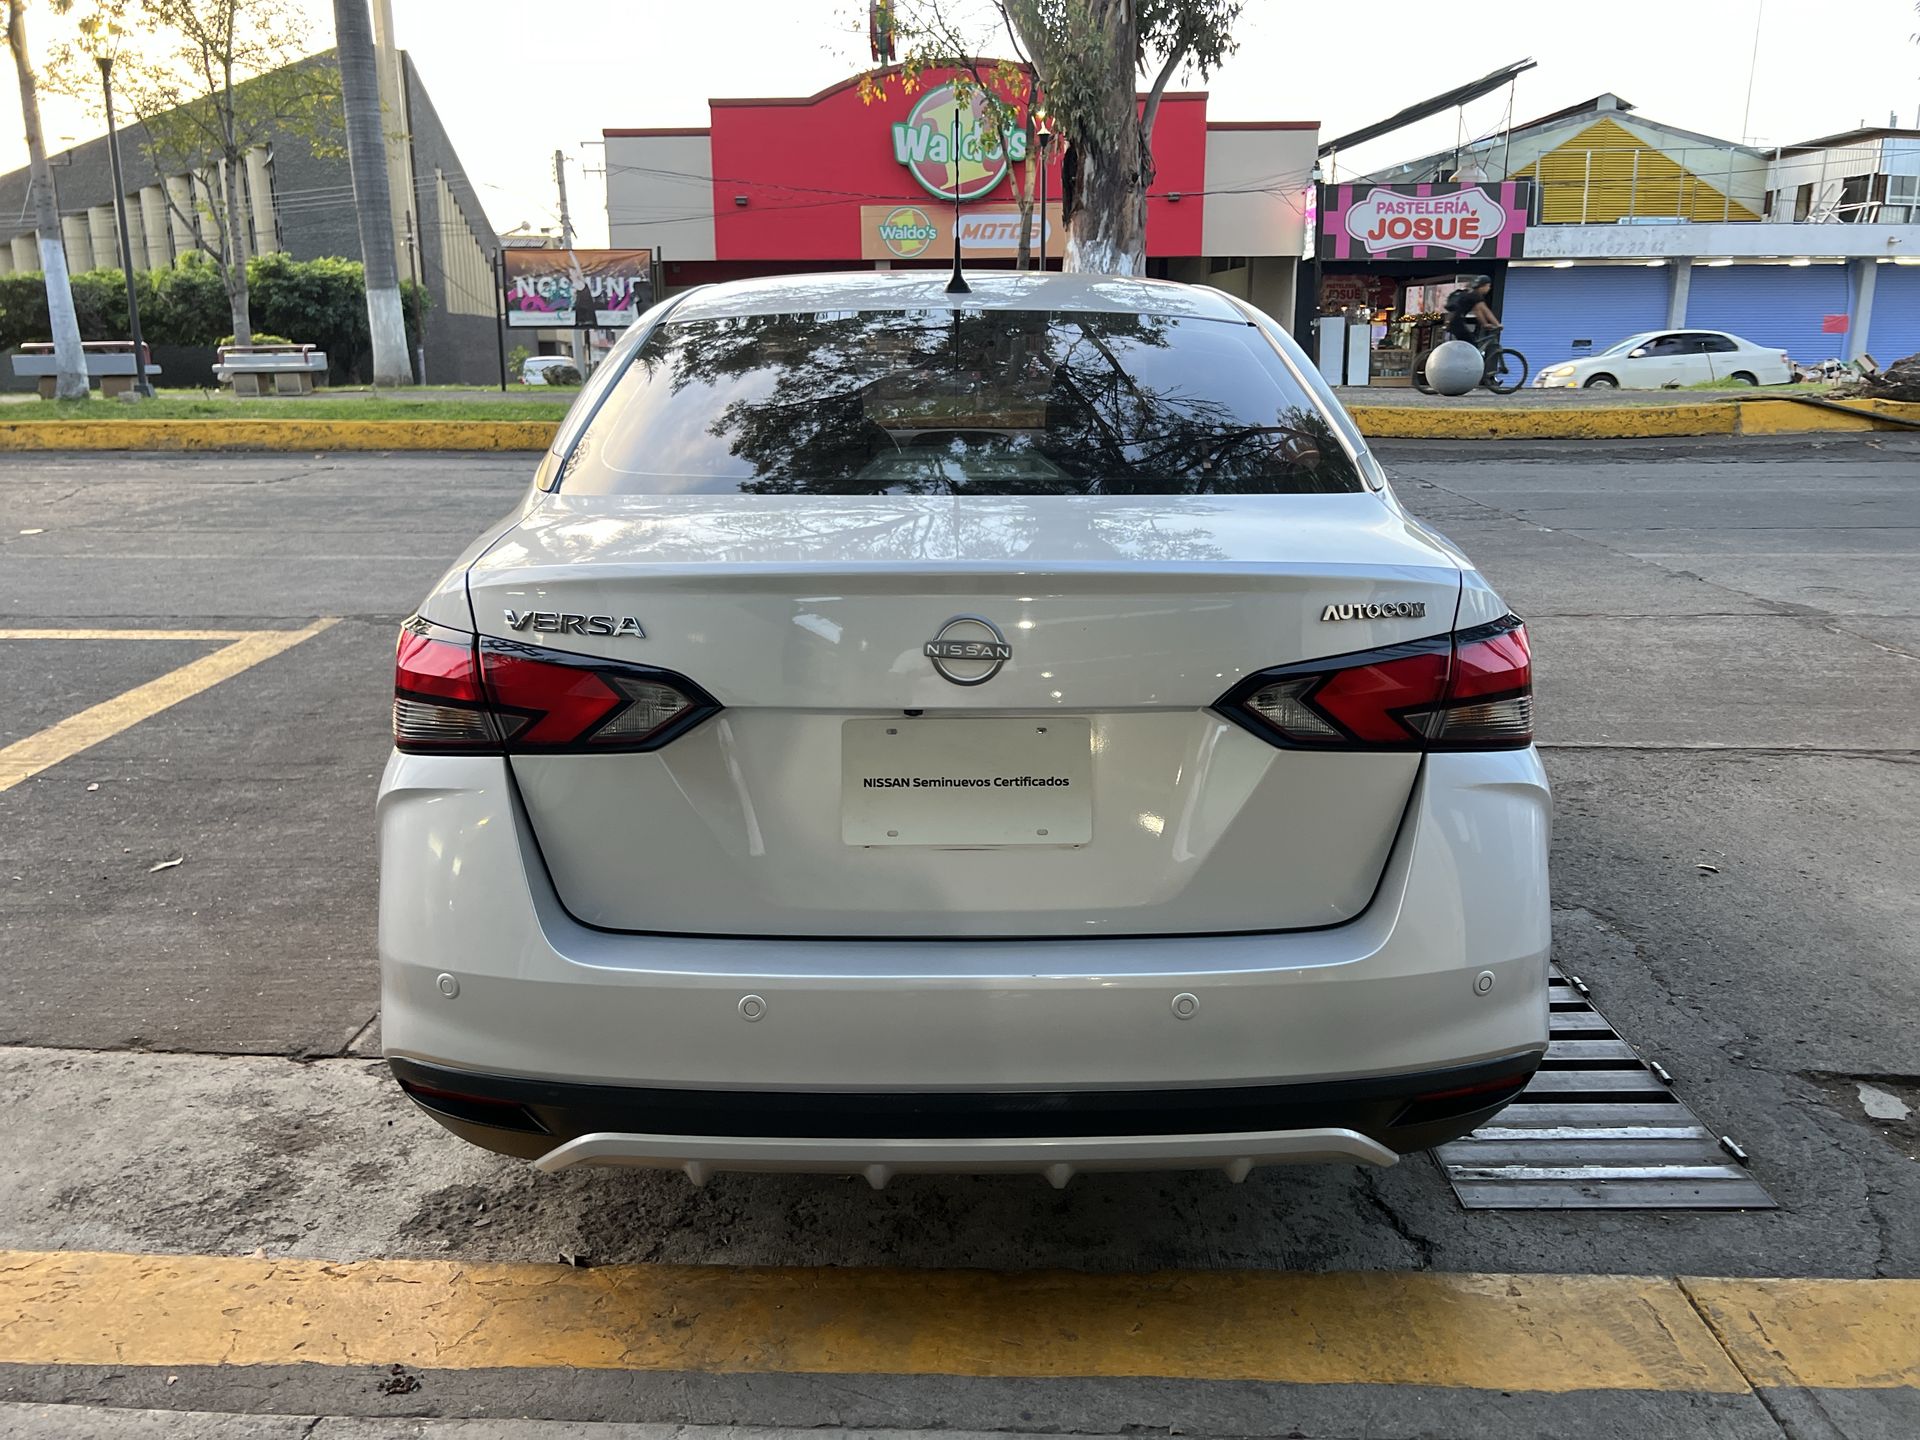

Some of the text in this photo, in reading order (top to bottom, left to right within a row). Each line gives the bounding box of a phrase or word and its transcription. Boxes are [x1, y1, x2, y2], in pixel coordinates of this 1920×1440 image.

[1376, 197, 1470, 214] PASTELERÍA
[879, 224, 937, 241] Waldo's
[1368, 209, 1481, 241] JOSUÉ
[1321, 602, 1426, 621] AUTOCOM
[504, 609, 645, 638] VERSA
[926, 644, 1010, 658] NISSAN
[863, 777, 1070, 788] NISSAN Seminuevos Certificados
